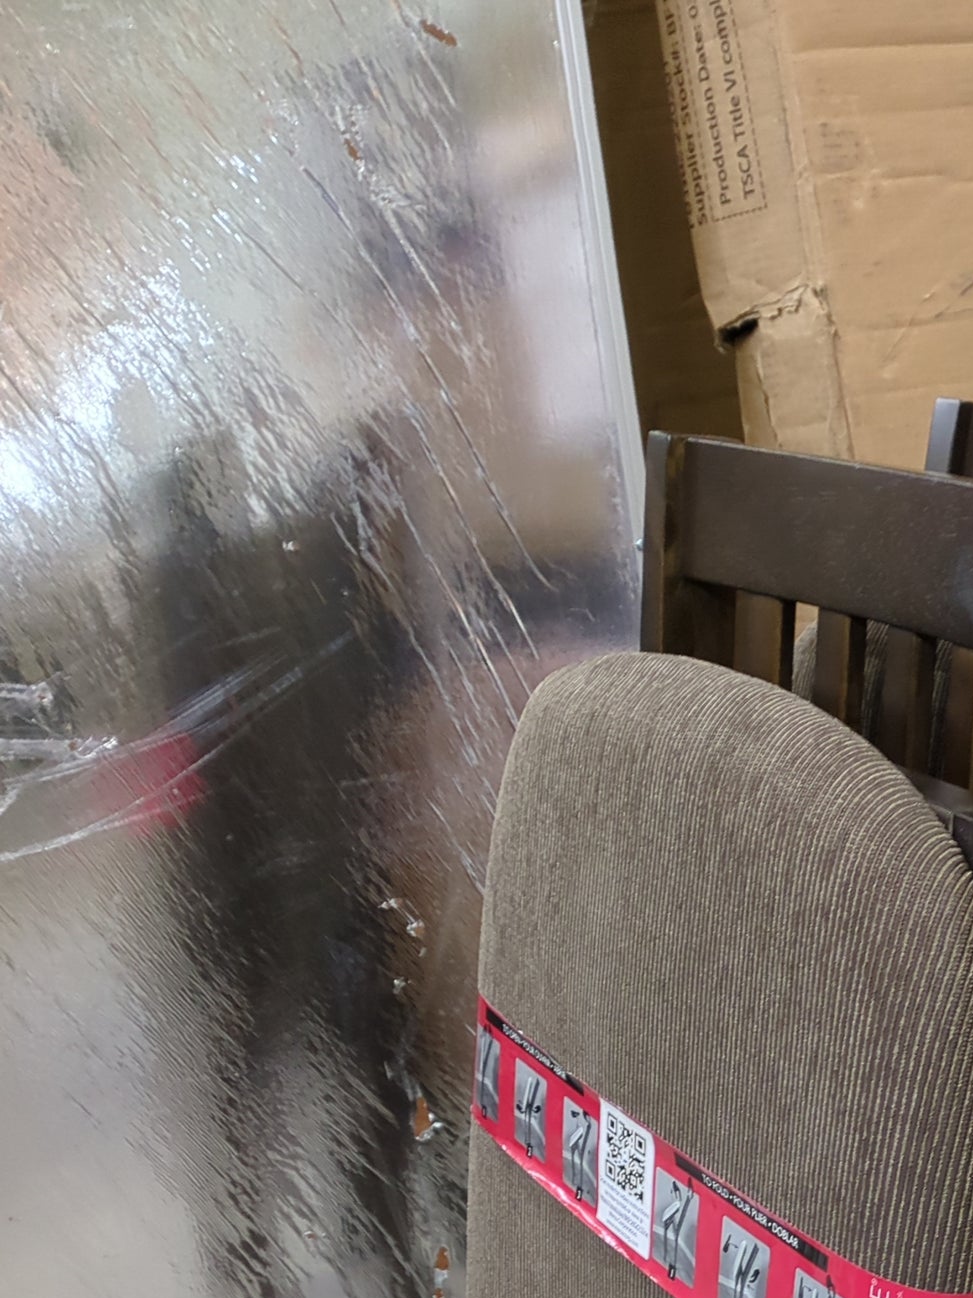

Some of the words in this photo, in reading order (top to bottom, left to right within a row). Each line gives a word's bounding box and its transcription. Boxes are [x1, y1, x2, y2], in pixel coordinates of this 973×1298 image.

[693, 25, 710, 83] Date:
[723, 70, 737, 92] VI
[704, 88, 731, 206] Production
[729, 96, 747, 142] Title
[686, 133, 708, 225] Supplier
[736, 144, 755, 199] TSCA
